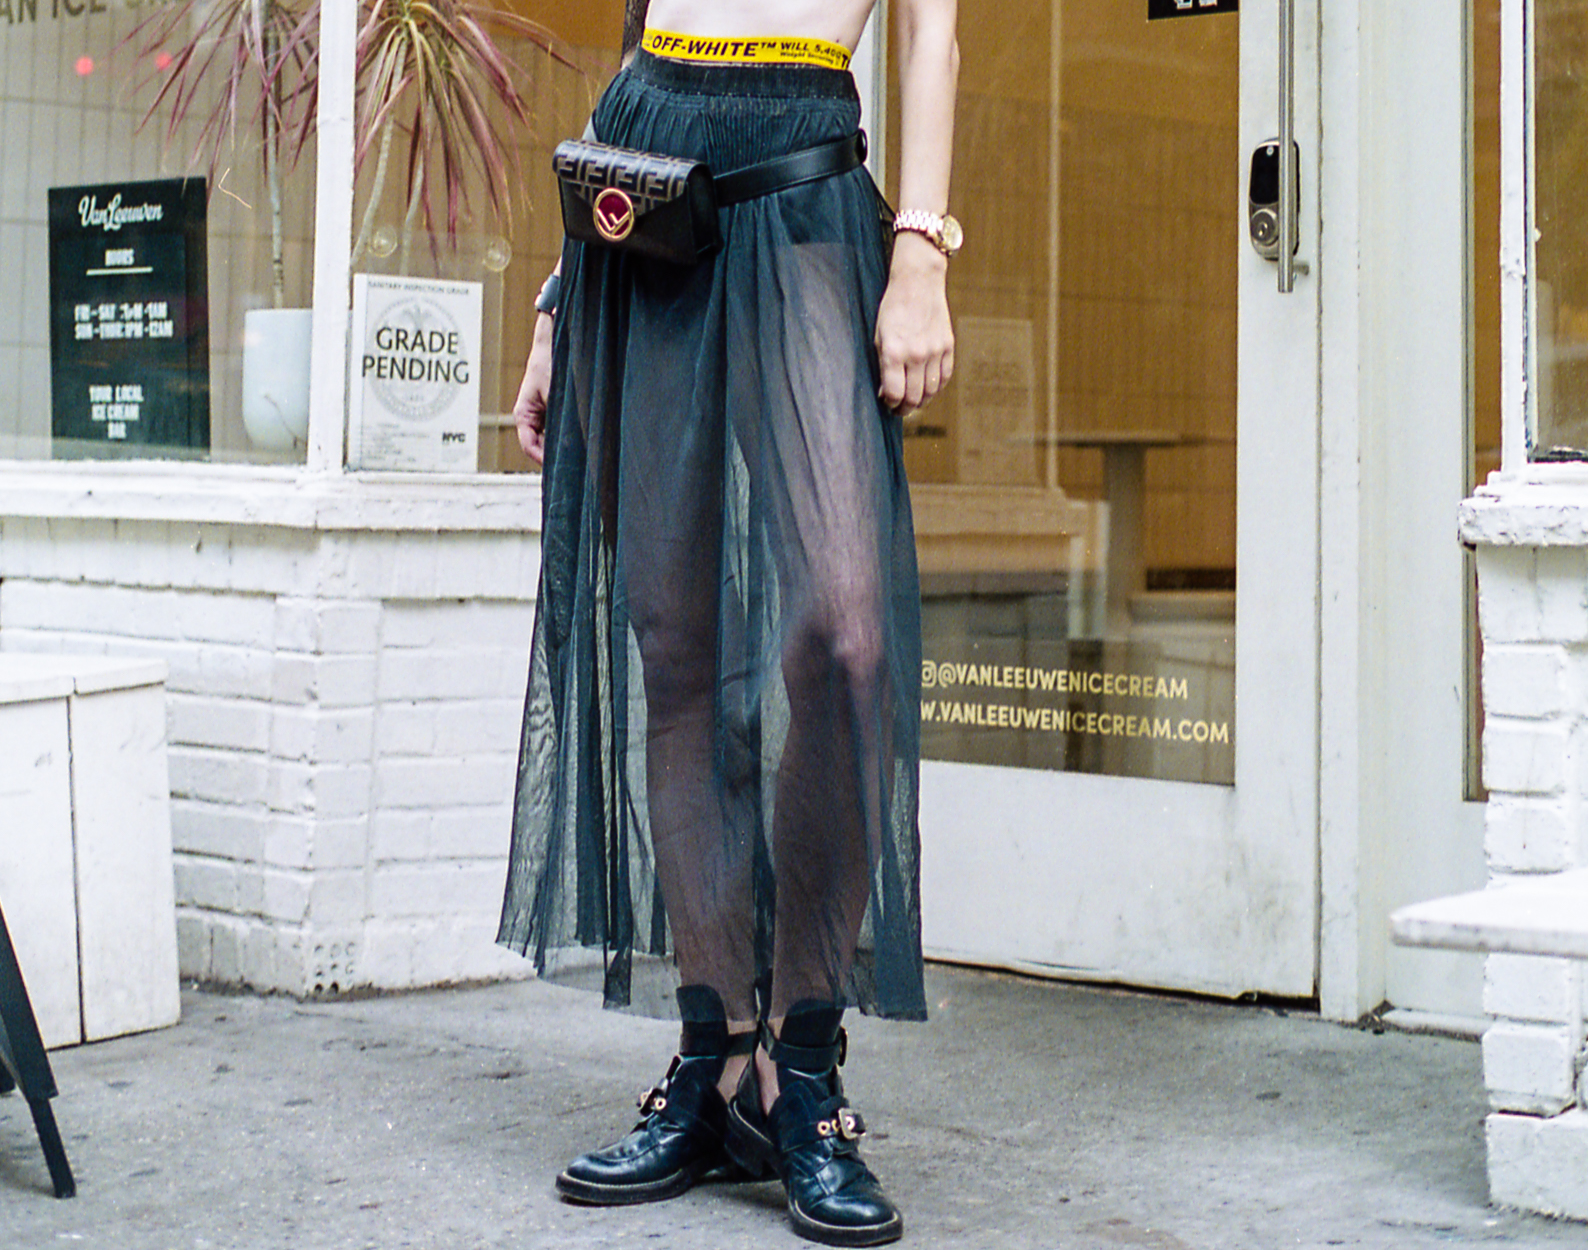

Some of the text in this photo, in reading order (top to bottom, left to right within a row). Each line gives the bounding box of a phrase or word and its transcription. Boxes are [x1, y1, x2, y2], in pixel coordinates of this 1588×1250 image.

[781, 42, 809, 51] WILL
[376, 326, 459, 355] GRADE
[362, 355, 470, 385] PENDING
[441, 431, 466, 443] NYC
